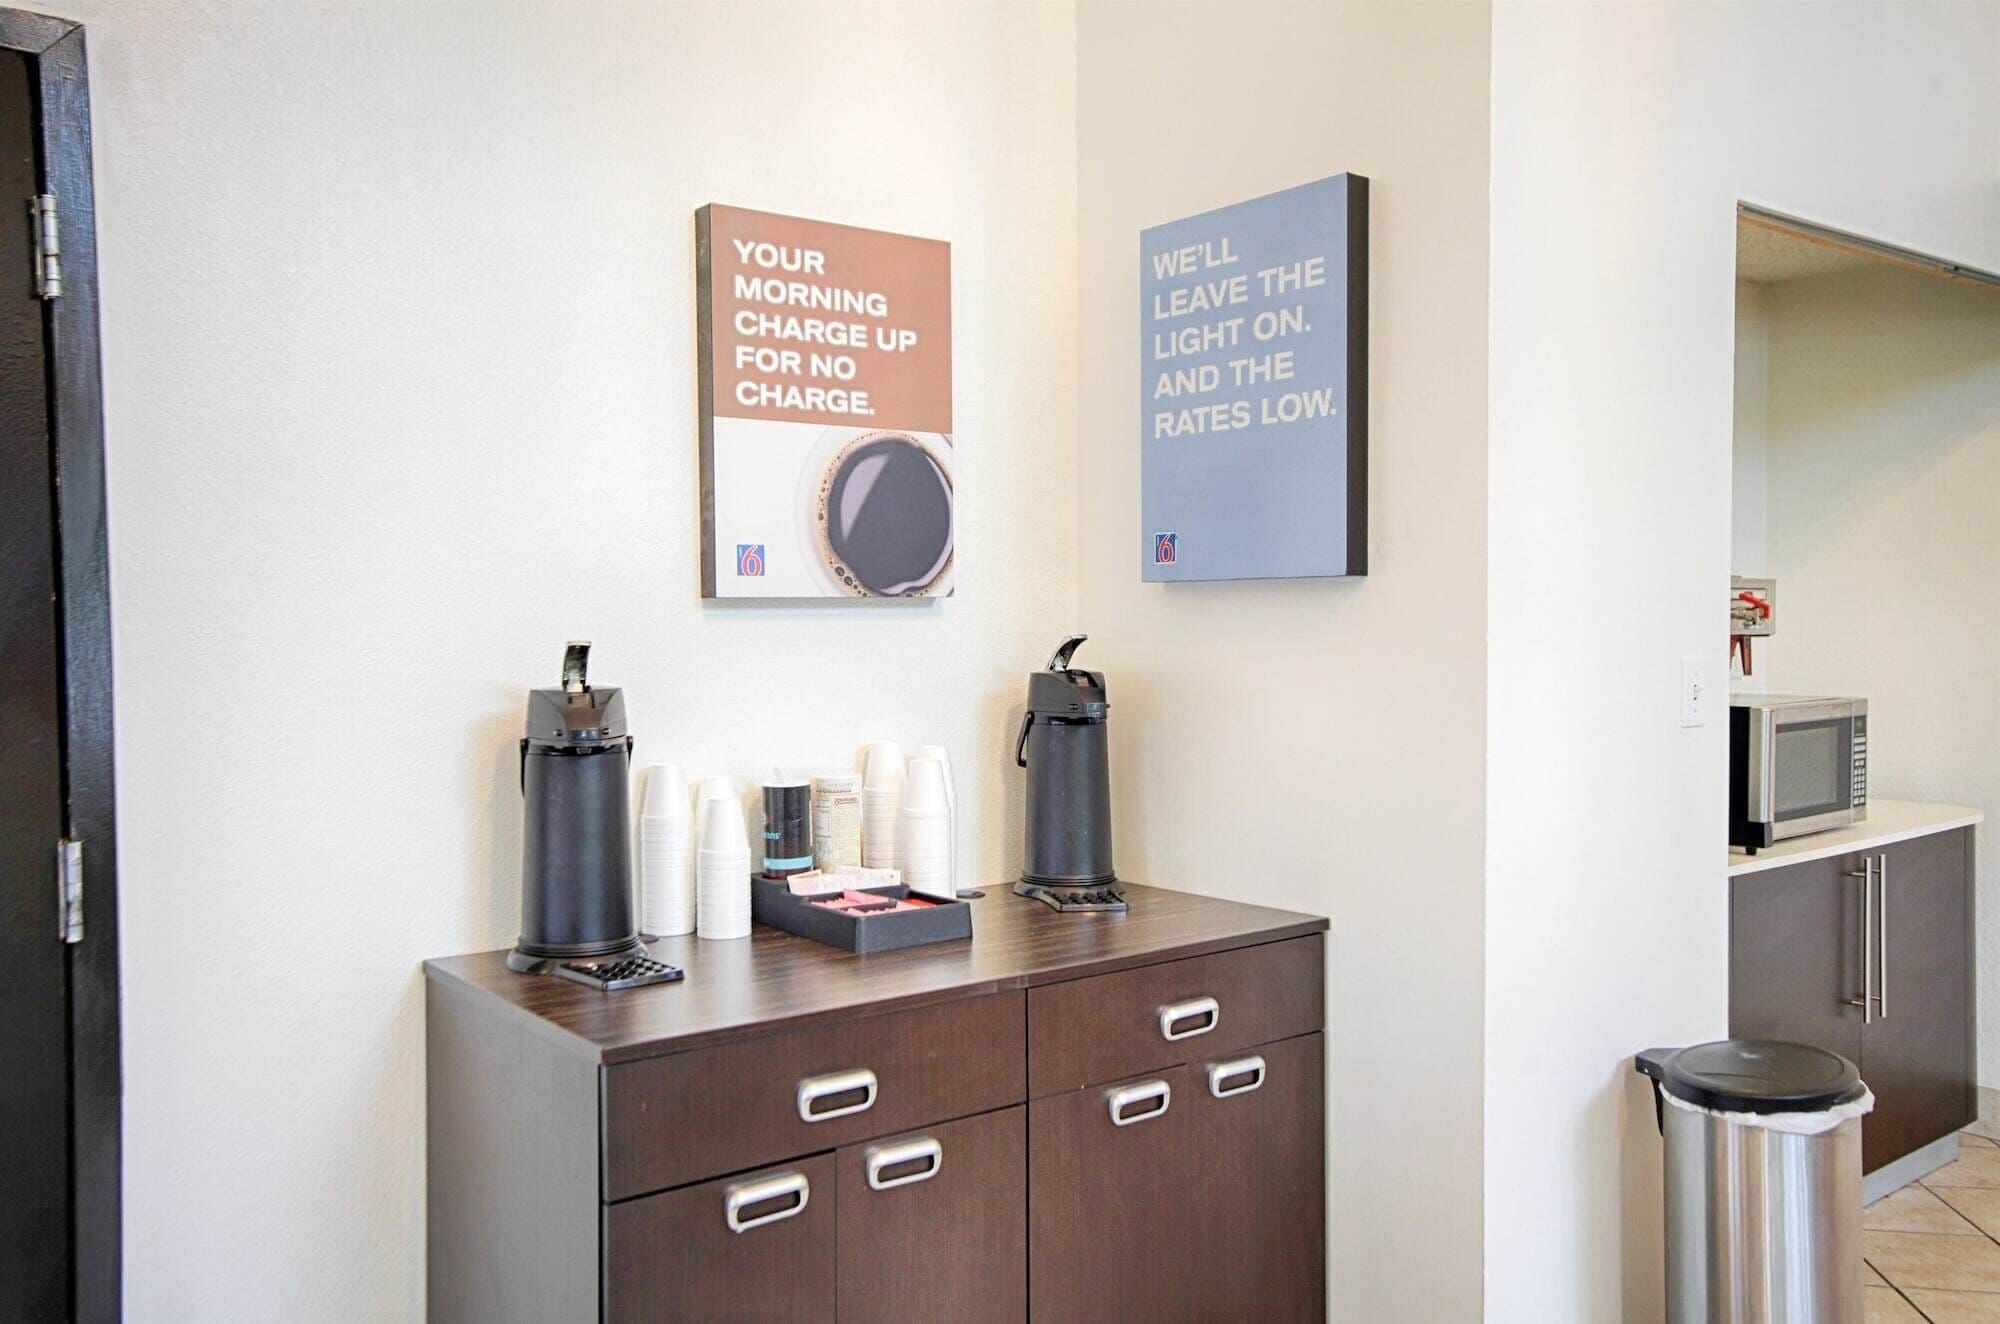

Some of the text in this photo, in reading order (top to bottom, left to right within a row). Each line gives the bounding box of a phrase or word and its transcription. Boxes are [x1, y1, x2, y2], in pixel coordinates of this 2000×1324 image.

[733, 239, 825, 275] YOUR
[735, 274, 888, 317] MORNING
[1154, 256, 1326, 320] LEAVE THE
[734, 310, 918, 352] CHARGE UP
[1154, 304, 1312, 360] LIGHT ON.
[735, 345, 857, 380] FOR NO
[1154, 350, 1295, 400] AND THE
[735, 380, 876, 415] CHARGE.
[1154, 387, 1337, 439] RATES LOW.
